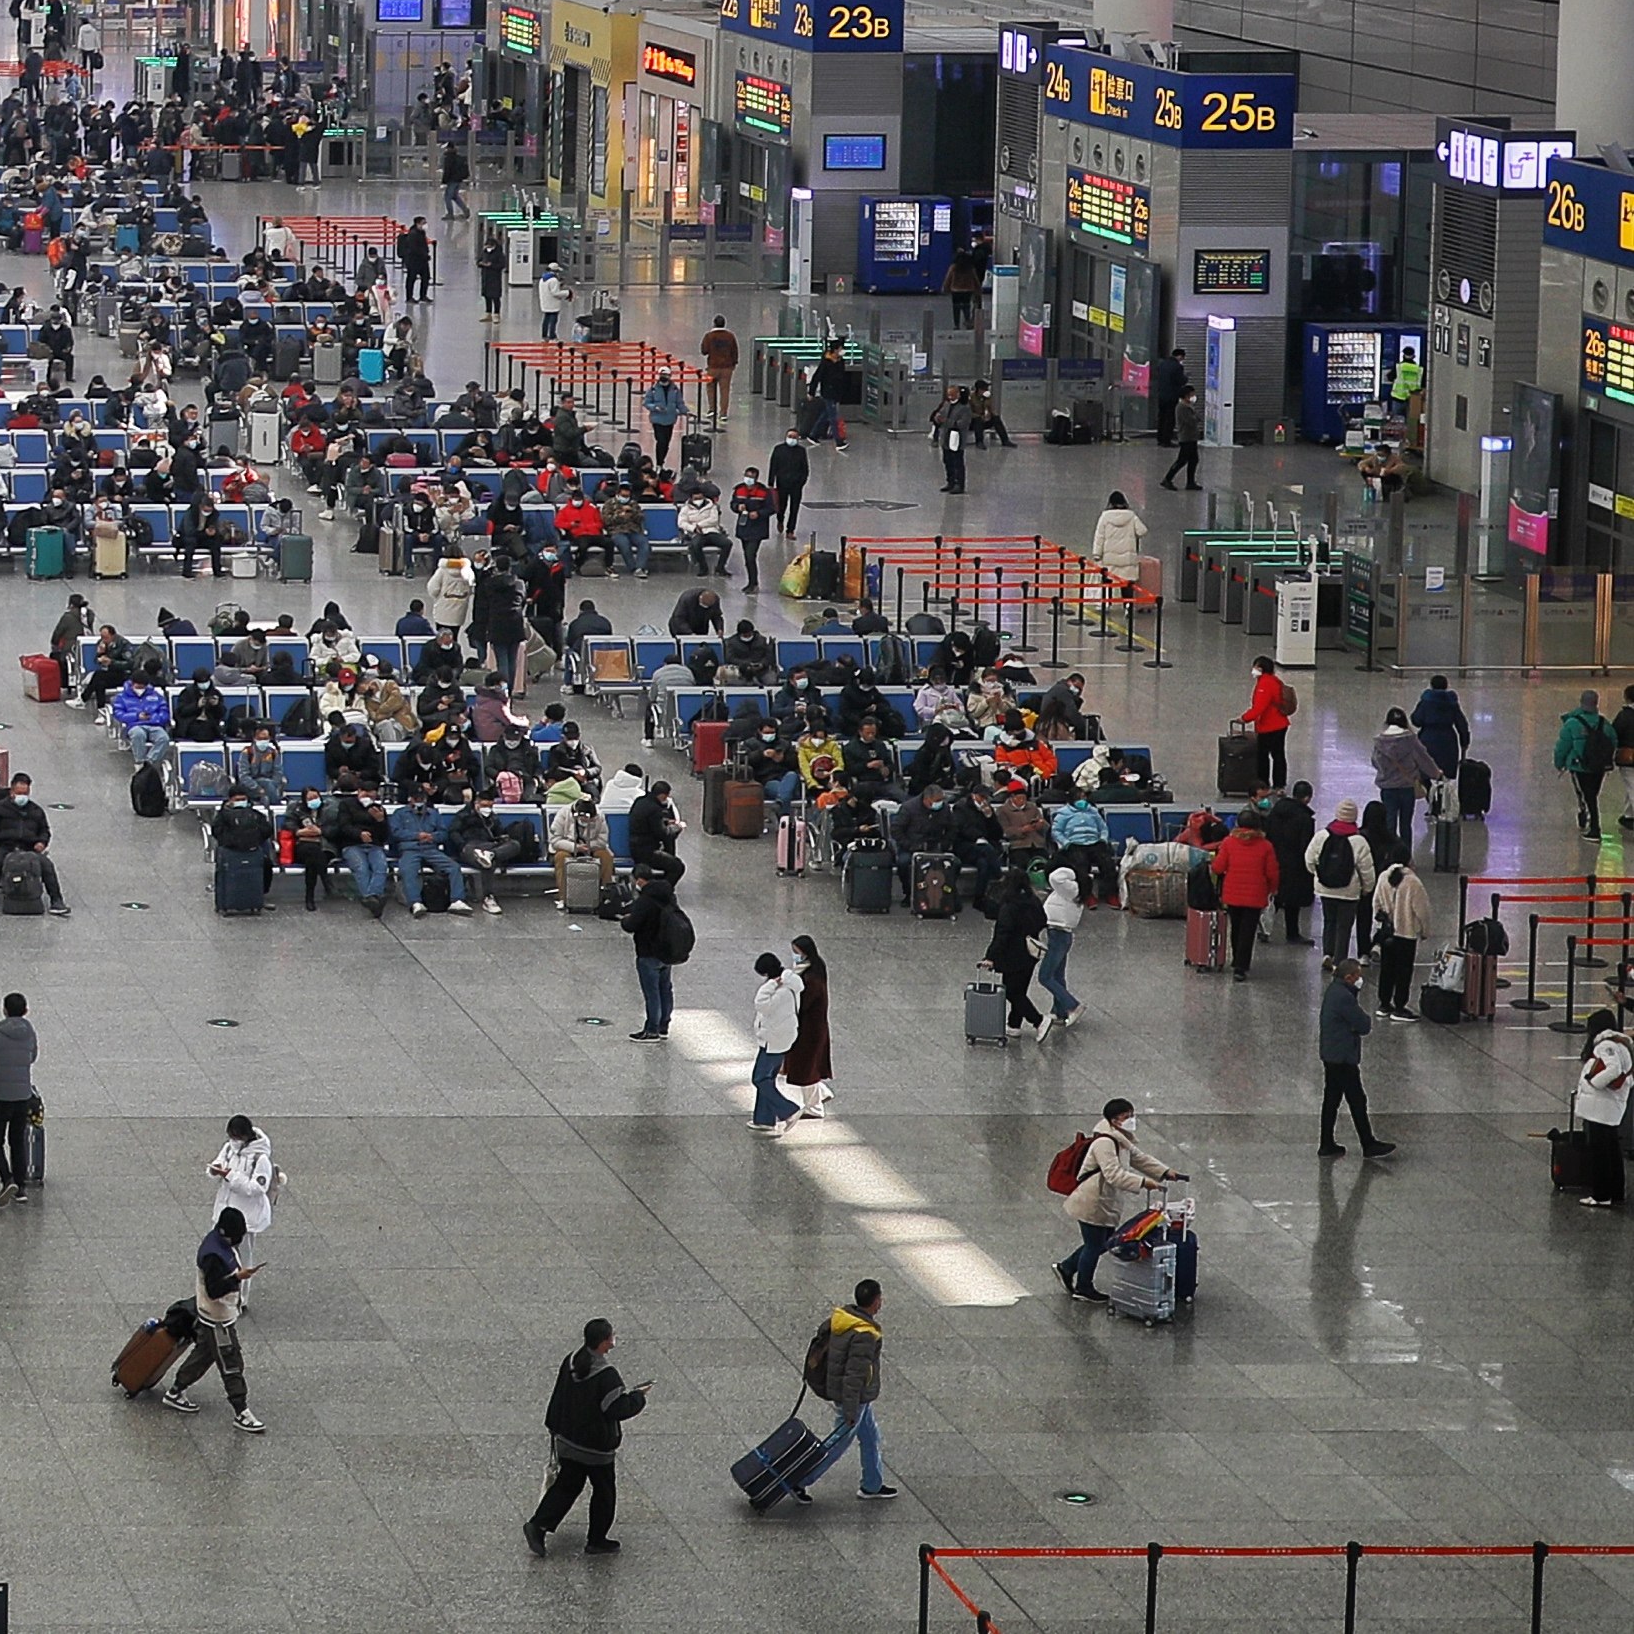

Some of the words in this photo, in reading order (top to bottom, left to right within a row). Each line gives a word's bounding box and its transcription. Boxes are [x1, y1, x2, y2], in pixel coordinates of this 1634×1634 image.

[794, 3, 814, 37] 23B
[828, 6, 891, 39] 23B
[1046, 62, 1071, 102] 24B
[1107, 73, 1134, 102] 检票口
[1107, 102, 1122, 117] Check
[1154, 87, 1182, 130] 25B
[1201, 91, 1277, 132] 25B
[1547, 181, 1585, 232] 26B
[1585, 328, 1606, 359] 26B
